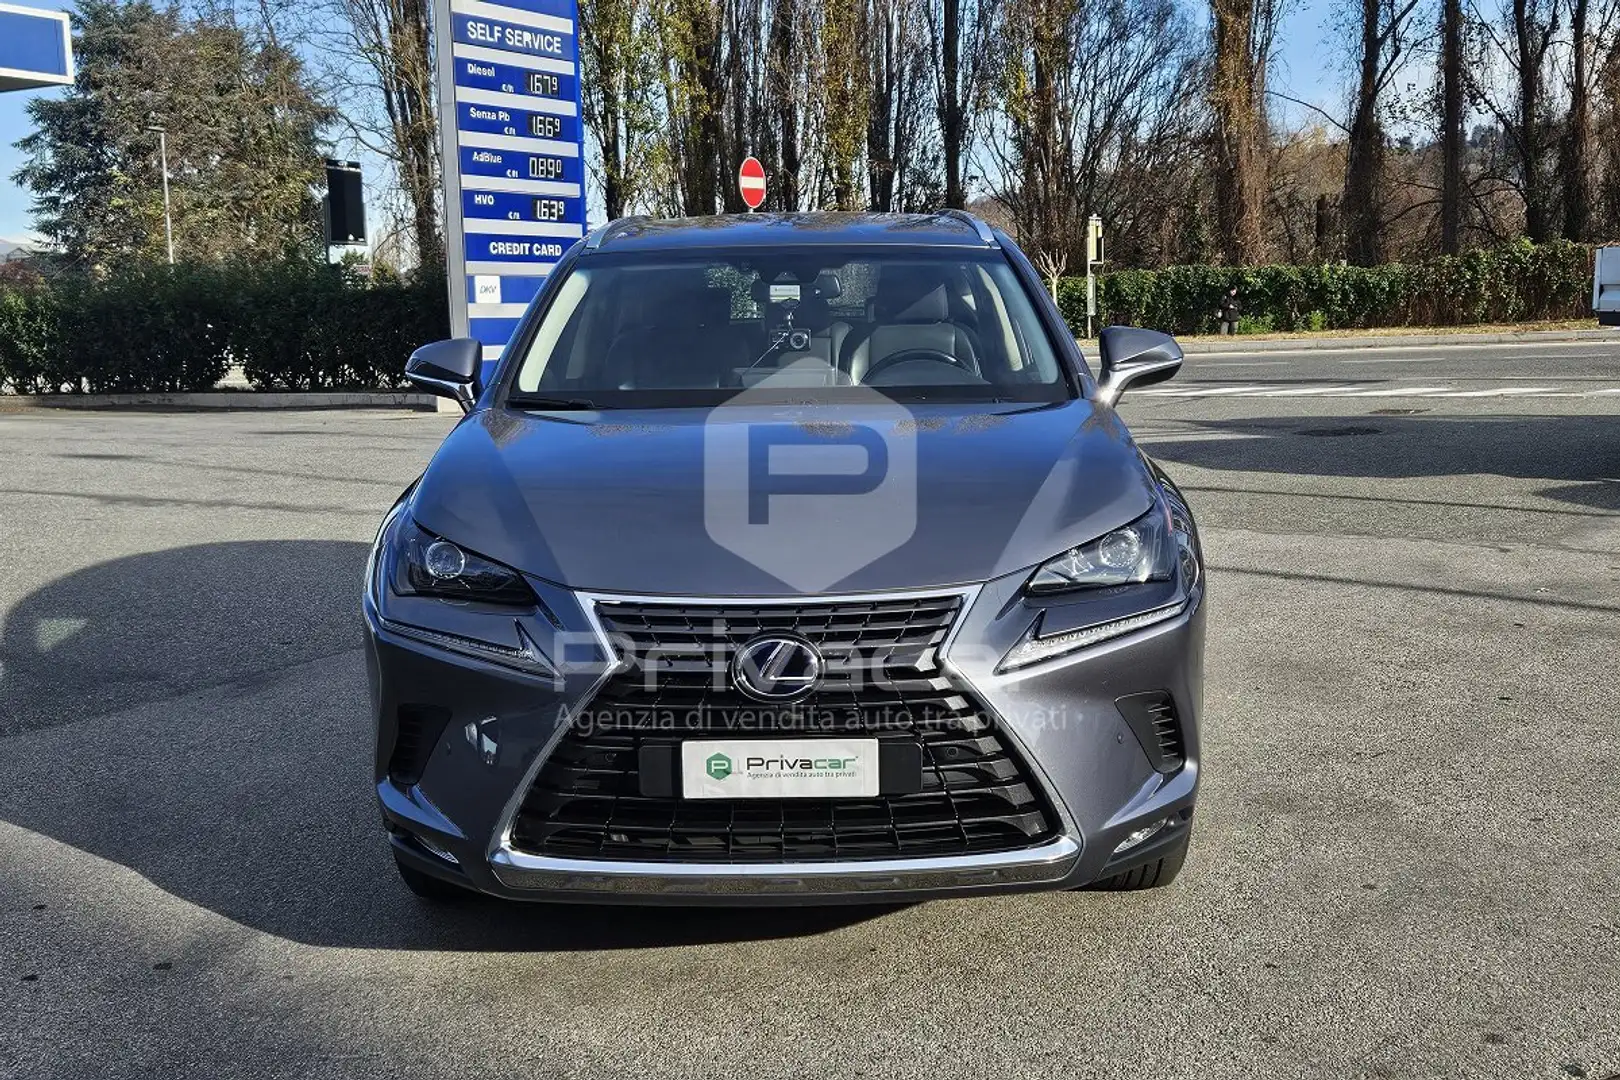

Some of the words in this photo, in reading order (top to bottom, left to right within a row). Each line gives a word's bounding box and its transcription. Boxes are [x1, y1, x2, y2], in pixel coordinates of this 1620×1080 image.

[467, 21, 502, 43] SELF
[505, 28, 562, 53] SERVICE
[467, 63, 495, 77] Diesel
[470, 107, 496, 120] Senza
[498, 111, 510, 122] Pb
[472, 151, 502, 163] AdBlue
[474, 194, 494, 205] HVO
[489, 242, 530, 255] CREDIT
[533, 243, 562, 257] CARD
[480, 285, 497, 294] DKV
[746, 754, 856, 770] Privacar
[747, 772, 773, 780] Agenzia
[835, 771, 856, 779] privati
